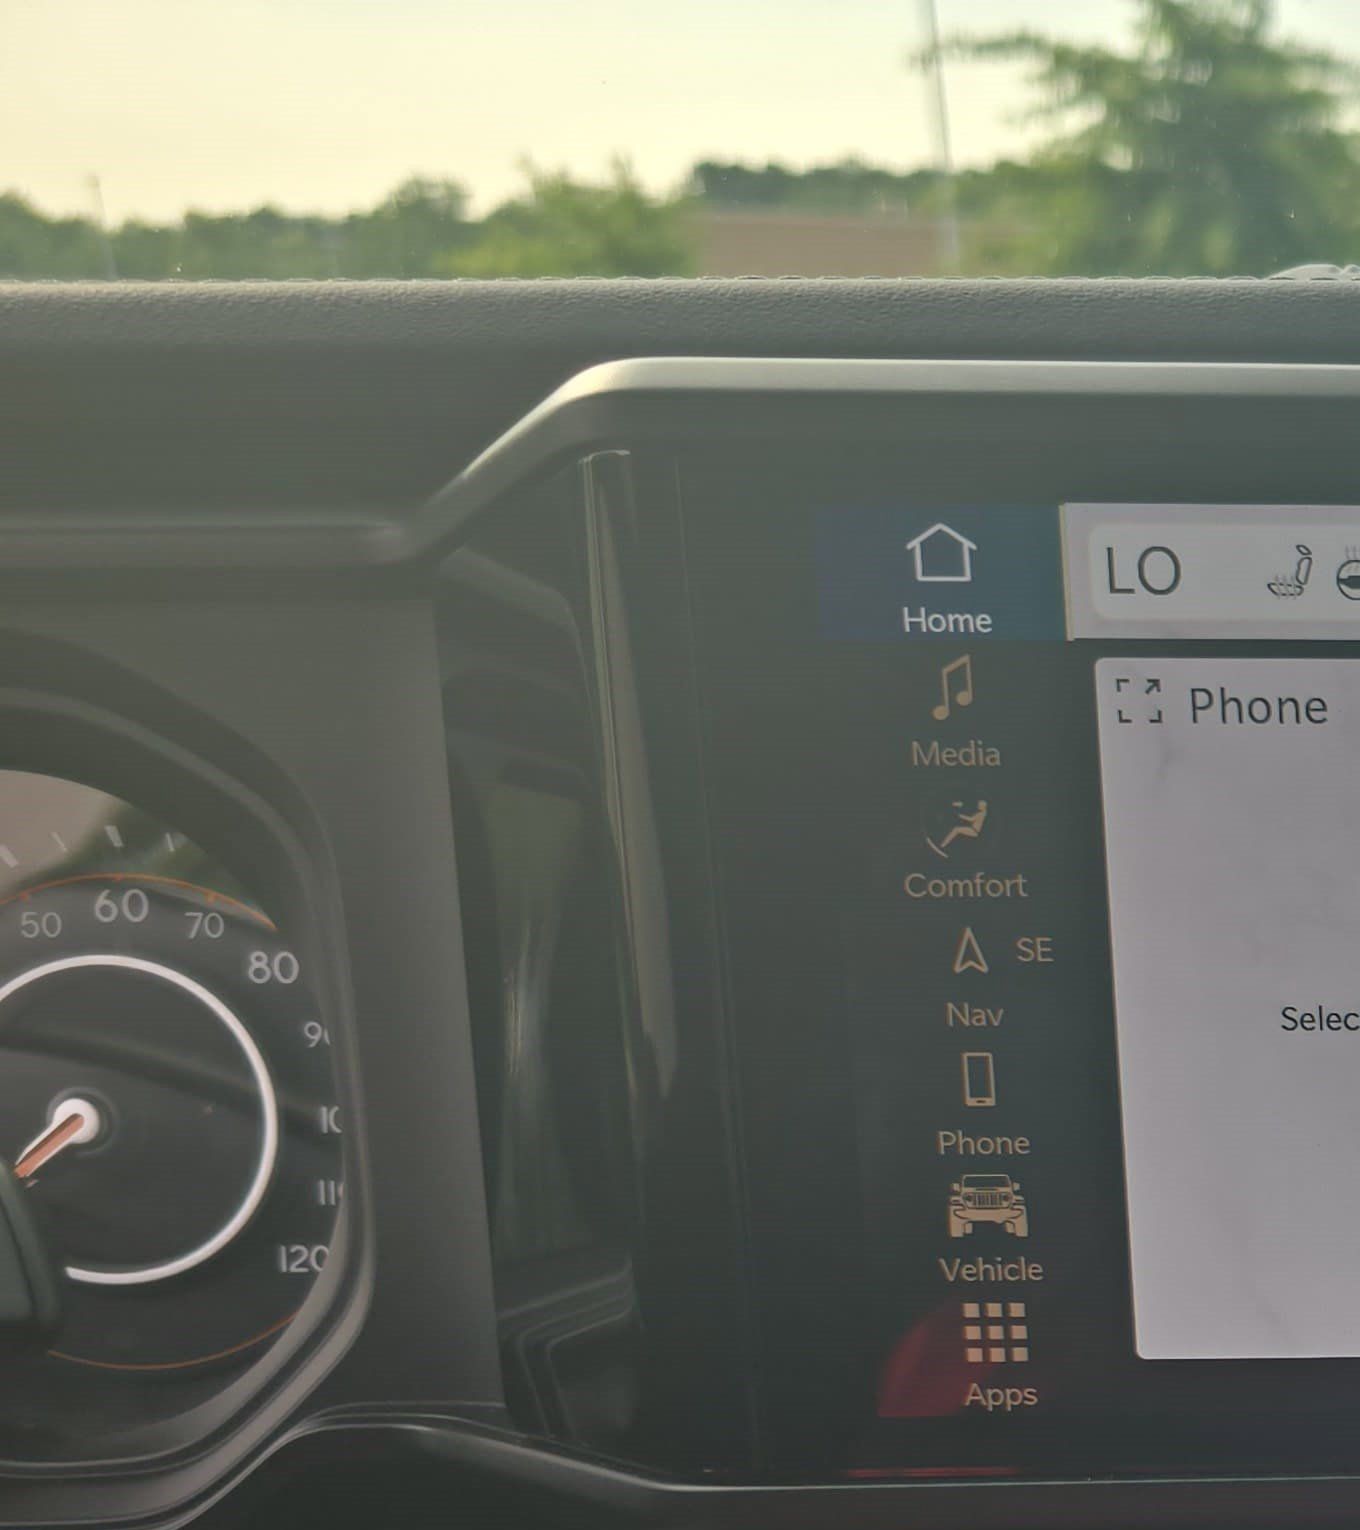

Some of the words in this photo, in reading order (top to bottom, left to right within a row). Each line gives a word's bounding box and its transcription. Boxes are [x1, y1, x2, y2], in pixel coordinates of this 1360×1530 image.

[1105, 545, 1182, 596] LO
[903, 606, 993, 633] Home
[1189, 687, 1329, 724] Phone
[911, 740, 1001, 767] Media
[904, 872, 1028, 898] Comfort
[93, 888, 149, 924] 60
[19, 911, 63, 940] 50
[184, 910, 225, 940] 70
[1016, 937, 1055, 963] SE
[247, 950, 300, 986] 80
[945, 1001, 1005, 1028] Nav
[936, 1130, 1031, 1156] Phone
[279, 1244, 332, 1275] 120
[937, 1256, 1045, 1283] Vehicle
[965, 1382, 1039, 1412] Apps
